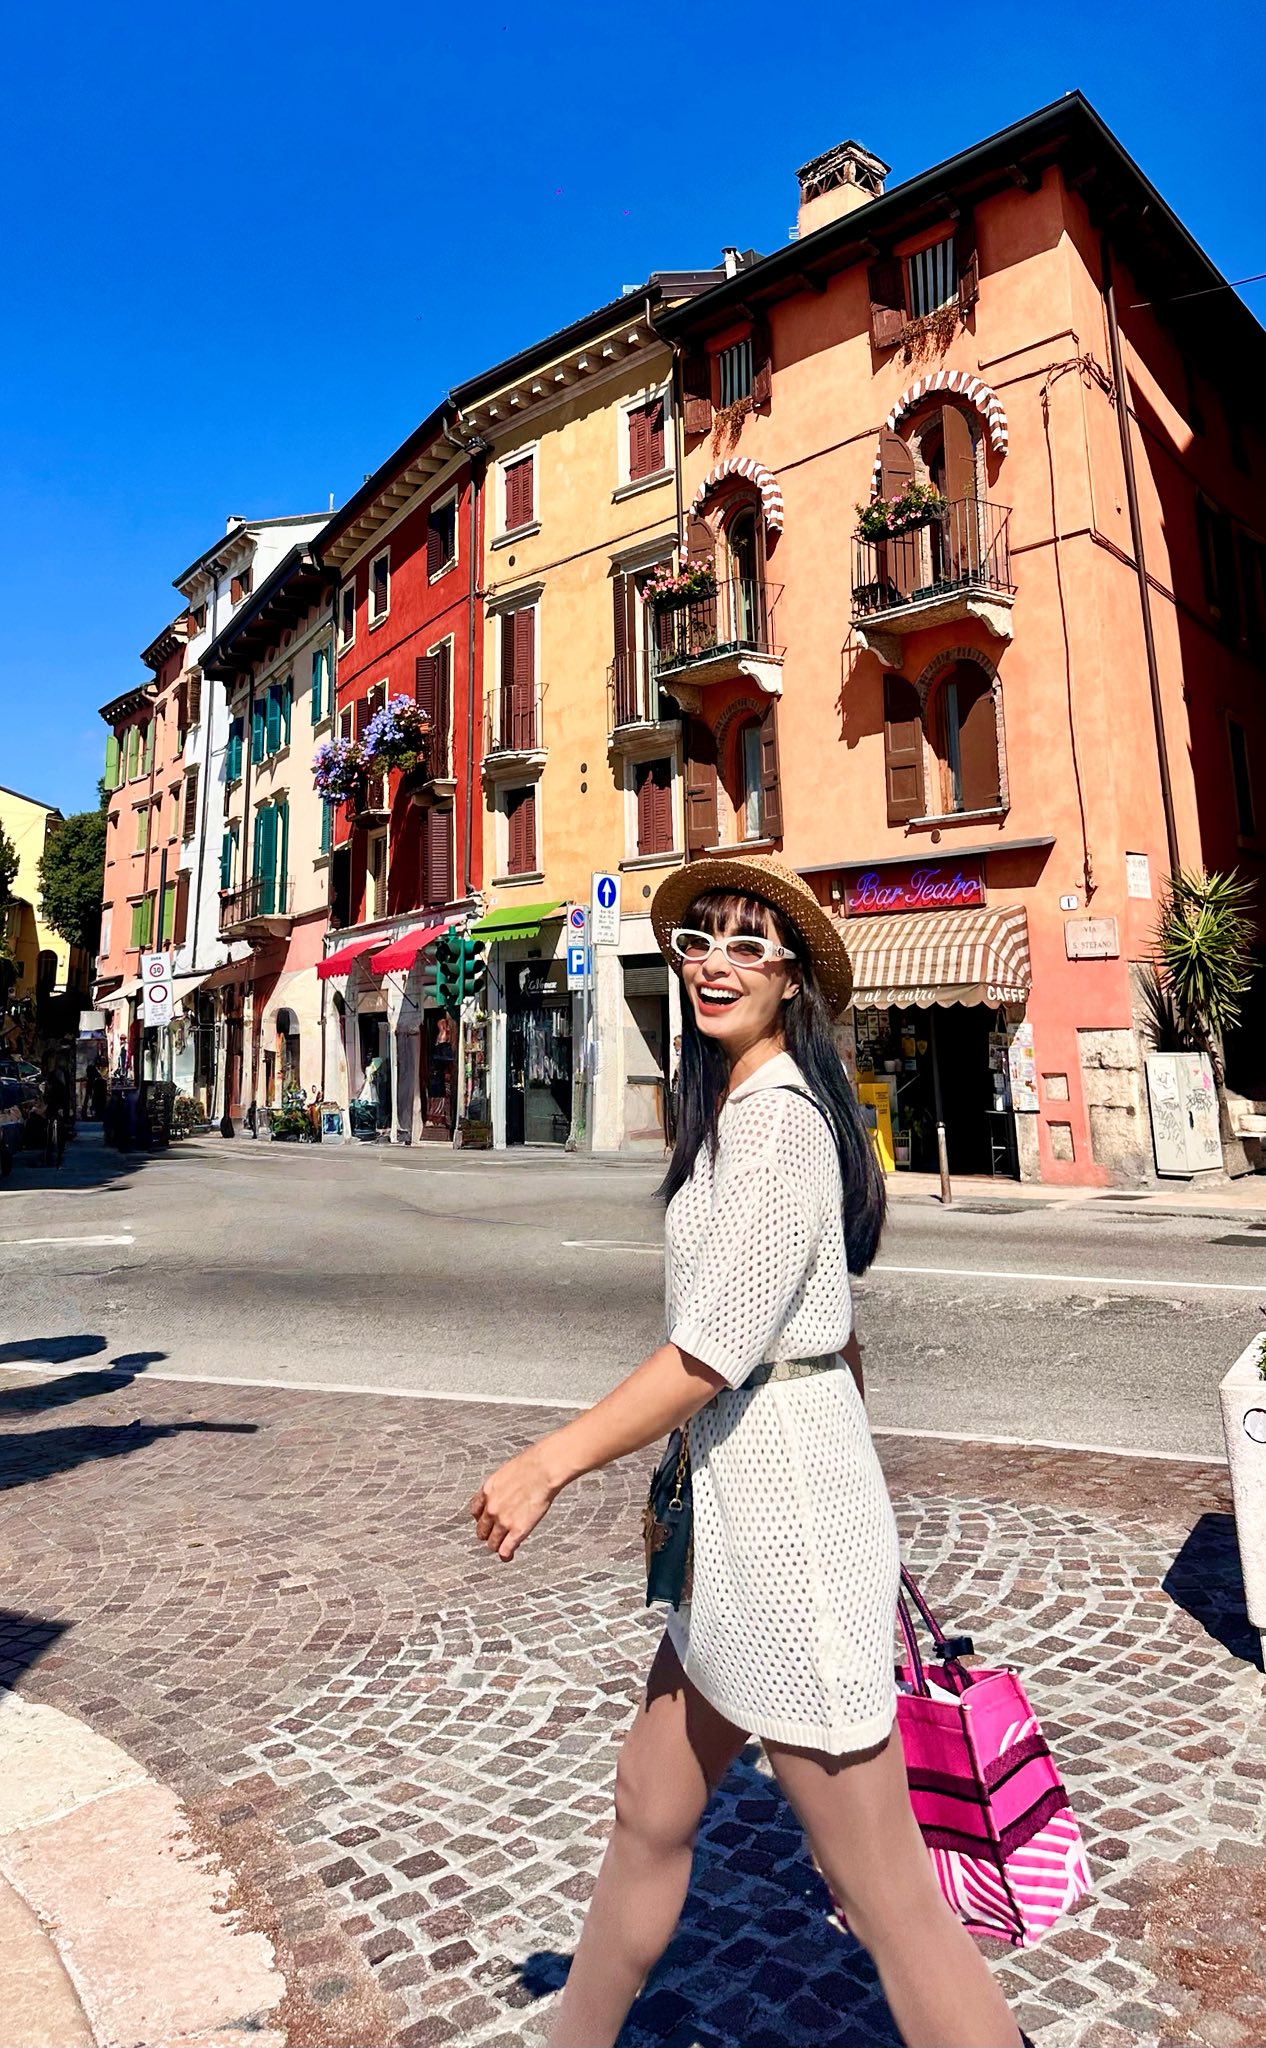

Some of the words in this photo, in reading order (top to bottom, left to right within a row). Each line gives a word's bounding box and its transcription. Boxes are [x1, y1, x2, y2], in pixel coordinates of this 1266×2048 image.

[849, 872, 904, 906] Bar
[904, 869, 981, 903] Teatro
[1083, 925, 1097, 933] VIA
[1081, 940, 1113, 950] STEFANO
[153, 966, 161, 975] 30
